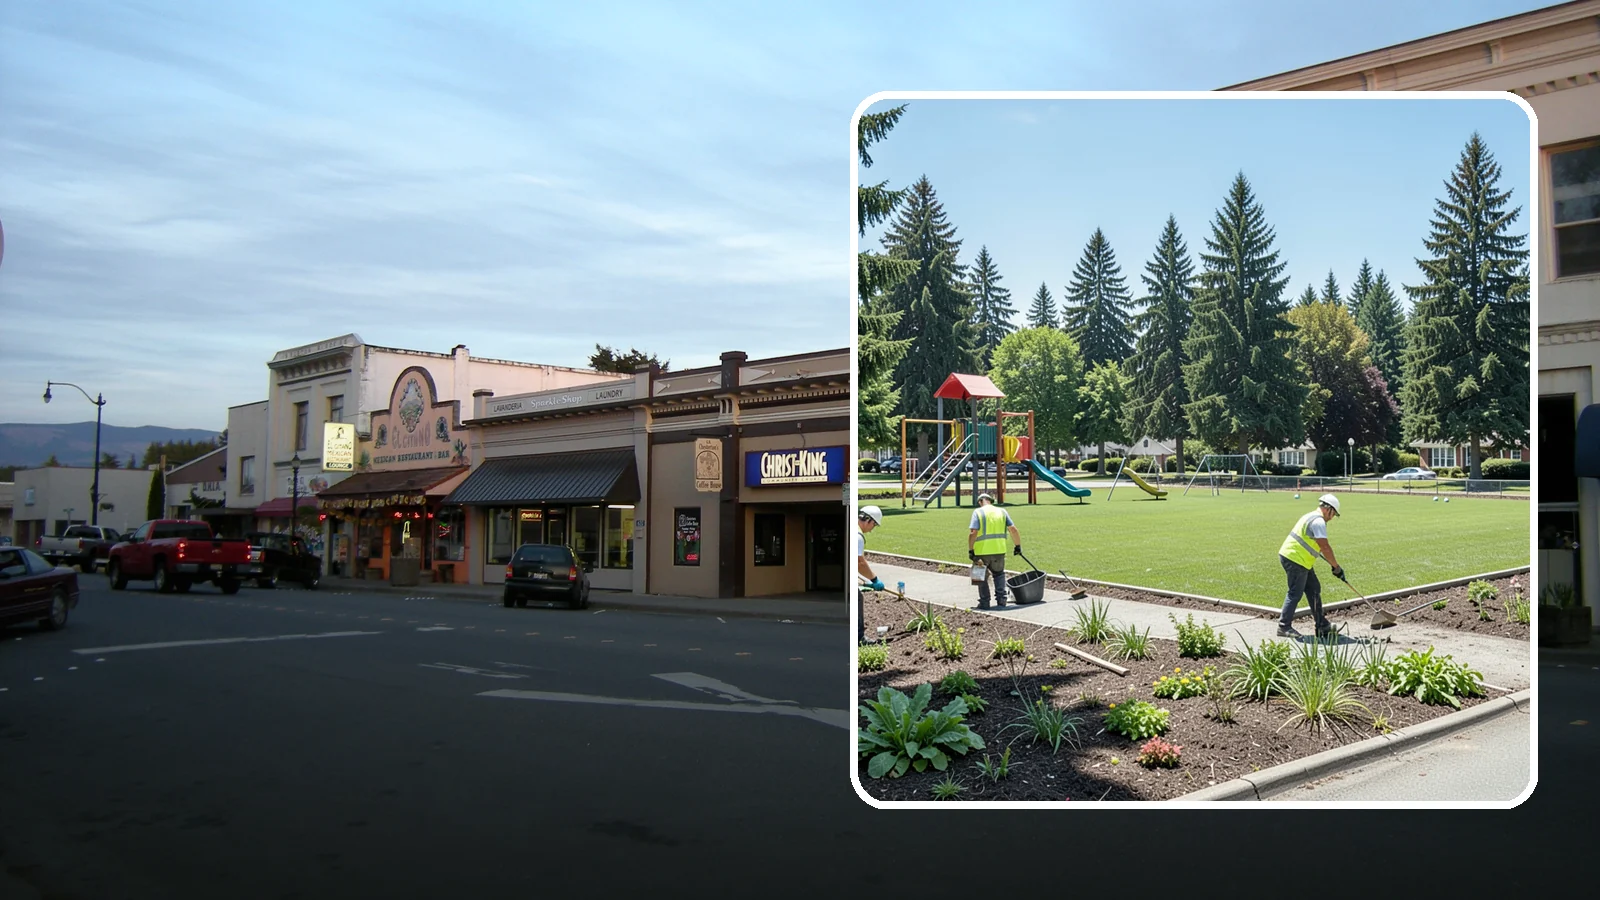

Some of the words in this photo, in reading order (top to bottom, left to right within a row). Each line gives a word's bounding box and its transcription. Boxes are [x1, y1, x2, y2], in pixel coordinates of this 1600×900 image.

[494, 402, 523, 412] LAVANDERIA
[531, 396, 561, 410] Sparkle
[562, 394, 582, 405] Shop
[595, 389, 623, 400] LAUNDRY
[374, 454, 396, 464] MEXICAN
[397, 451, 433, 462] RESTAURANT
[438, 450, 450, 459] BAR
[761, 452, 798, 478] CHRIST
[799, 450, 827, 476] KING
[697, 481, 709, 489] Coffee
